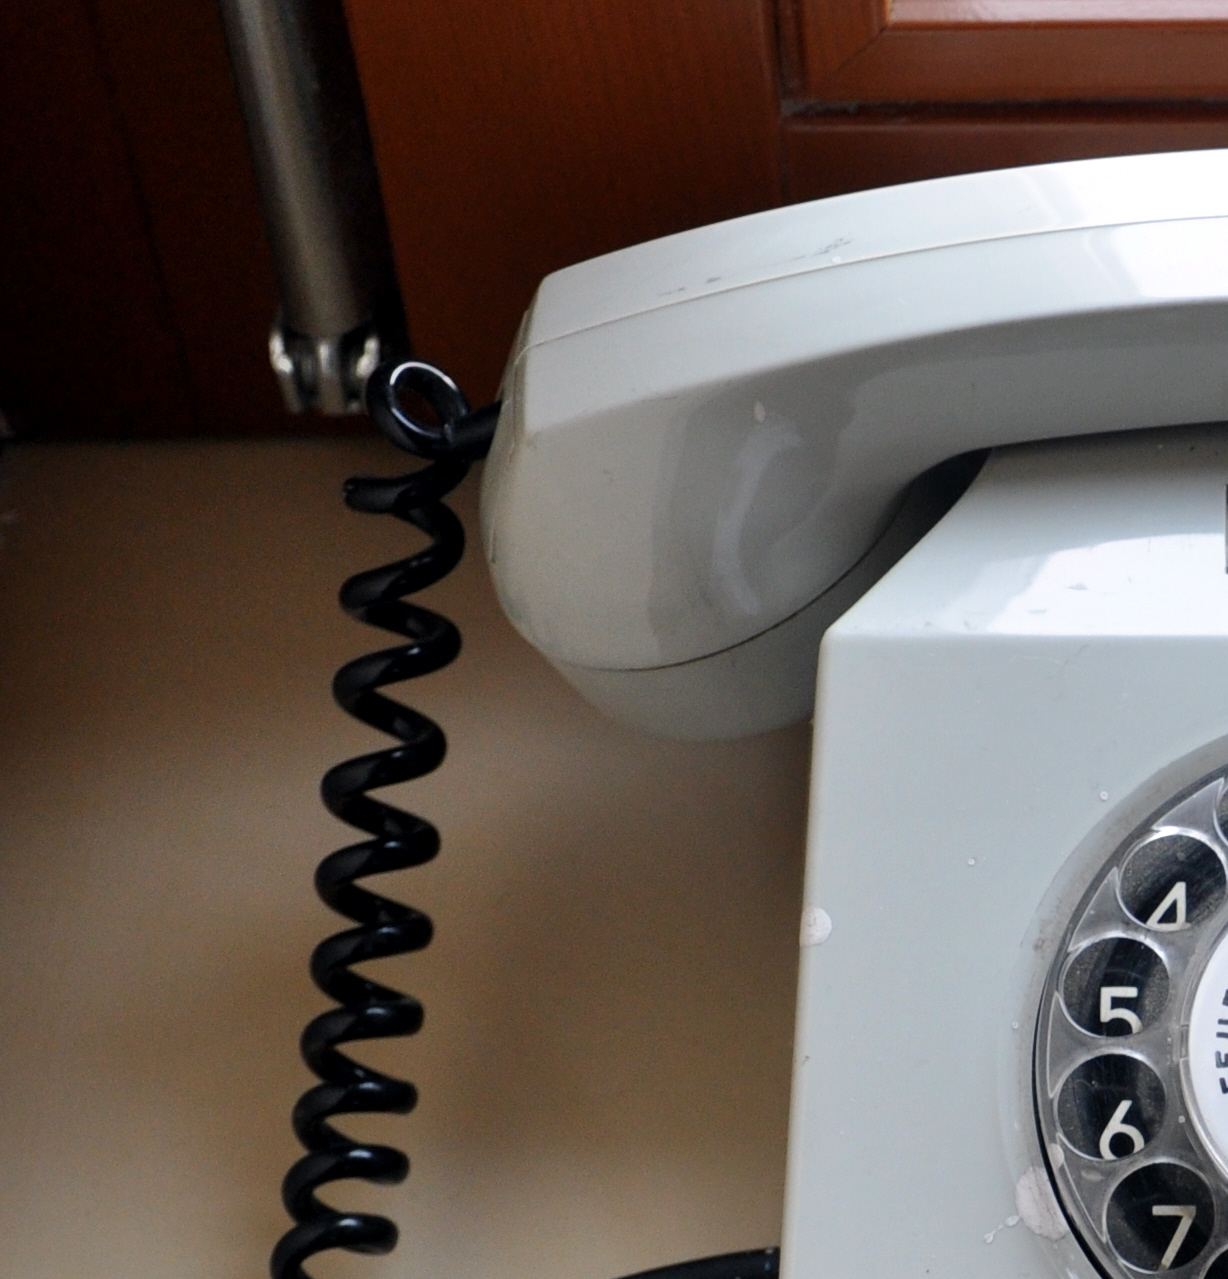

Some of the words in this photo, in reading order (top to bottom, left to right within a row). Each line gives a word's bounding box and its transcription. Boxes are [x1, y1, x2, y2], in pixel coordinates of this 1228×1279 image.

[1145, 882, 1190, 931] 4
[1100, 986, 1140, 1034] 5
[1100, 1100, 1145, 1159] 6
[1152, 1204, 1197, 1269] 7
